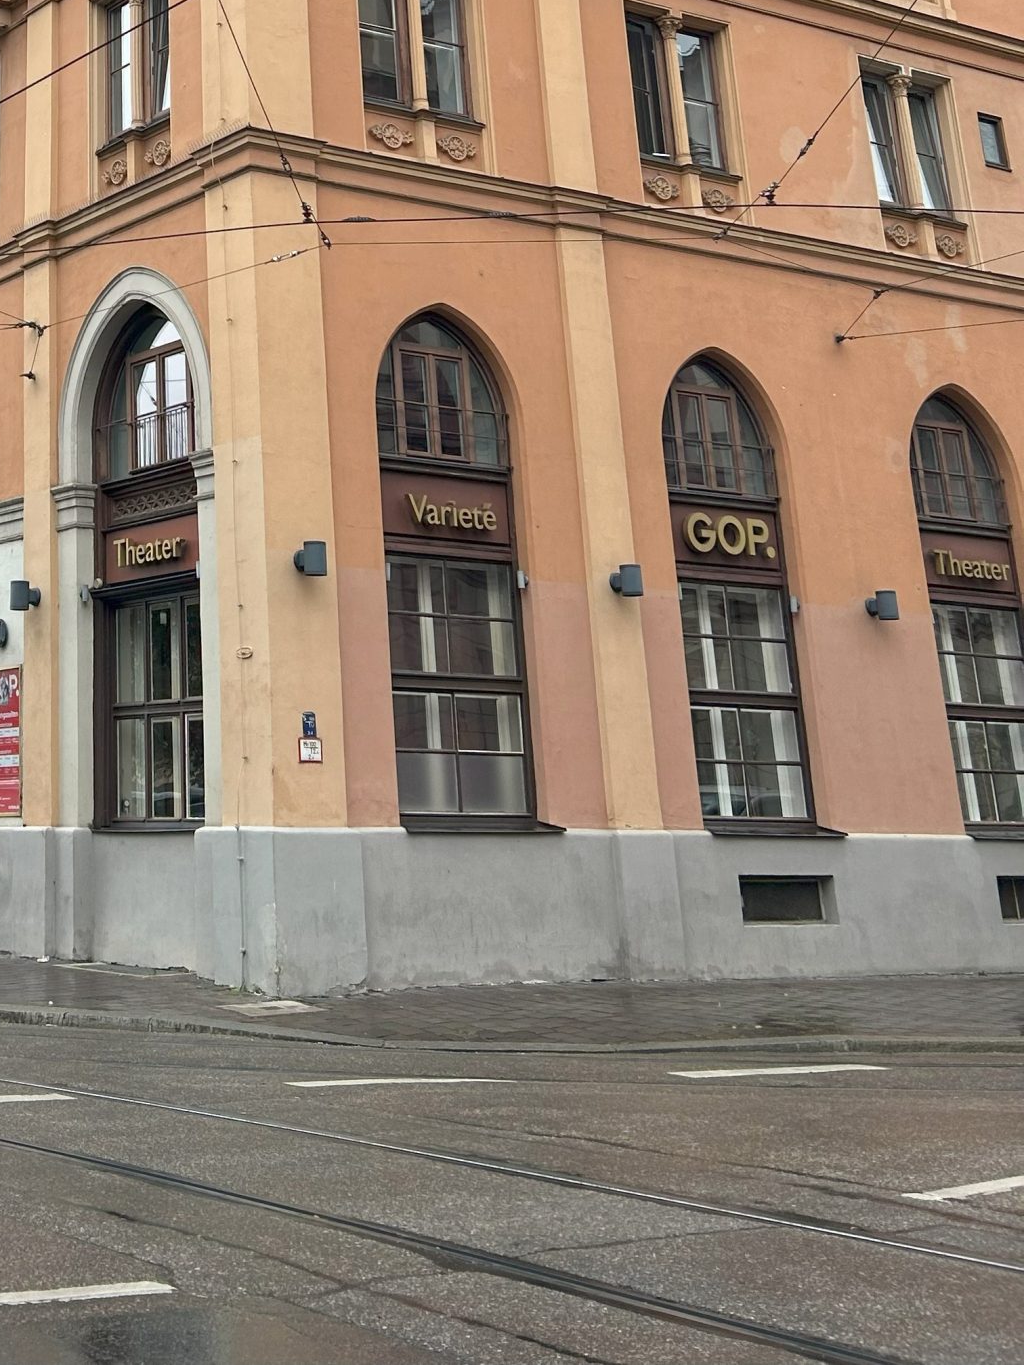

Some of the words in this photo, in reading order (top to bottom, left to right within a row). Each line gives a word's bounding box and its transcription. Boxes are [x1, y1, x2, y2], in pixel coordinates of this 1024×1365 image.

[406, 493, 497, 531] Varieté
[113, 537, 184, 567] Theater
[933, 549, 1010, 581] Theater
